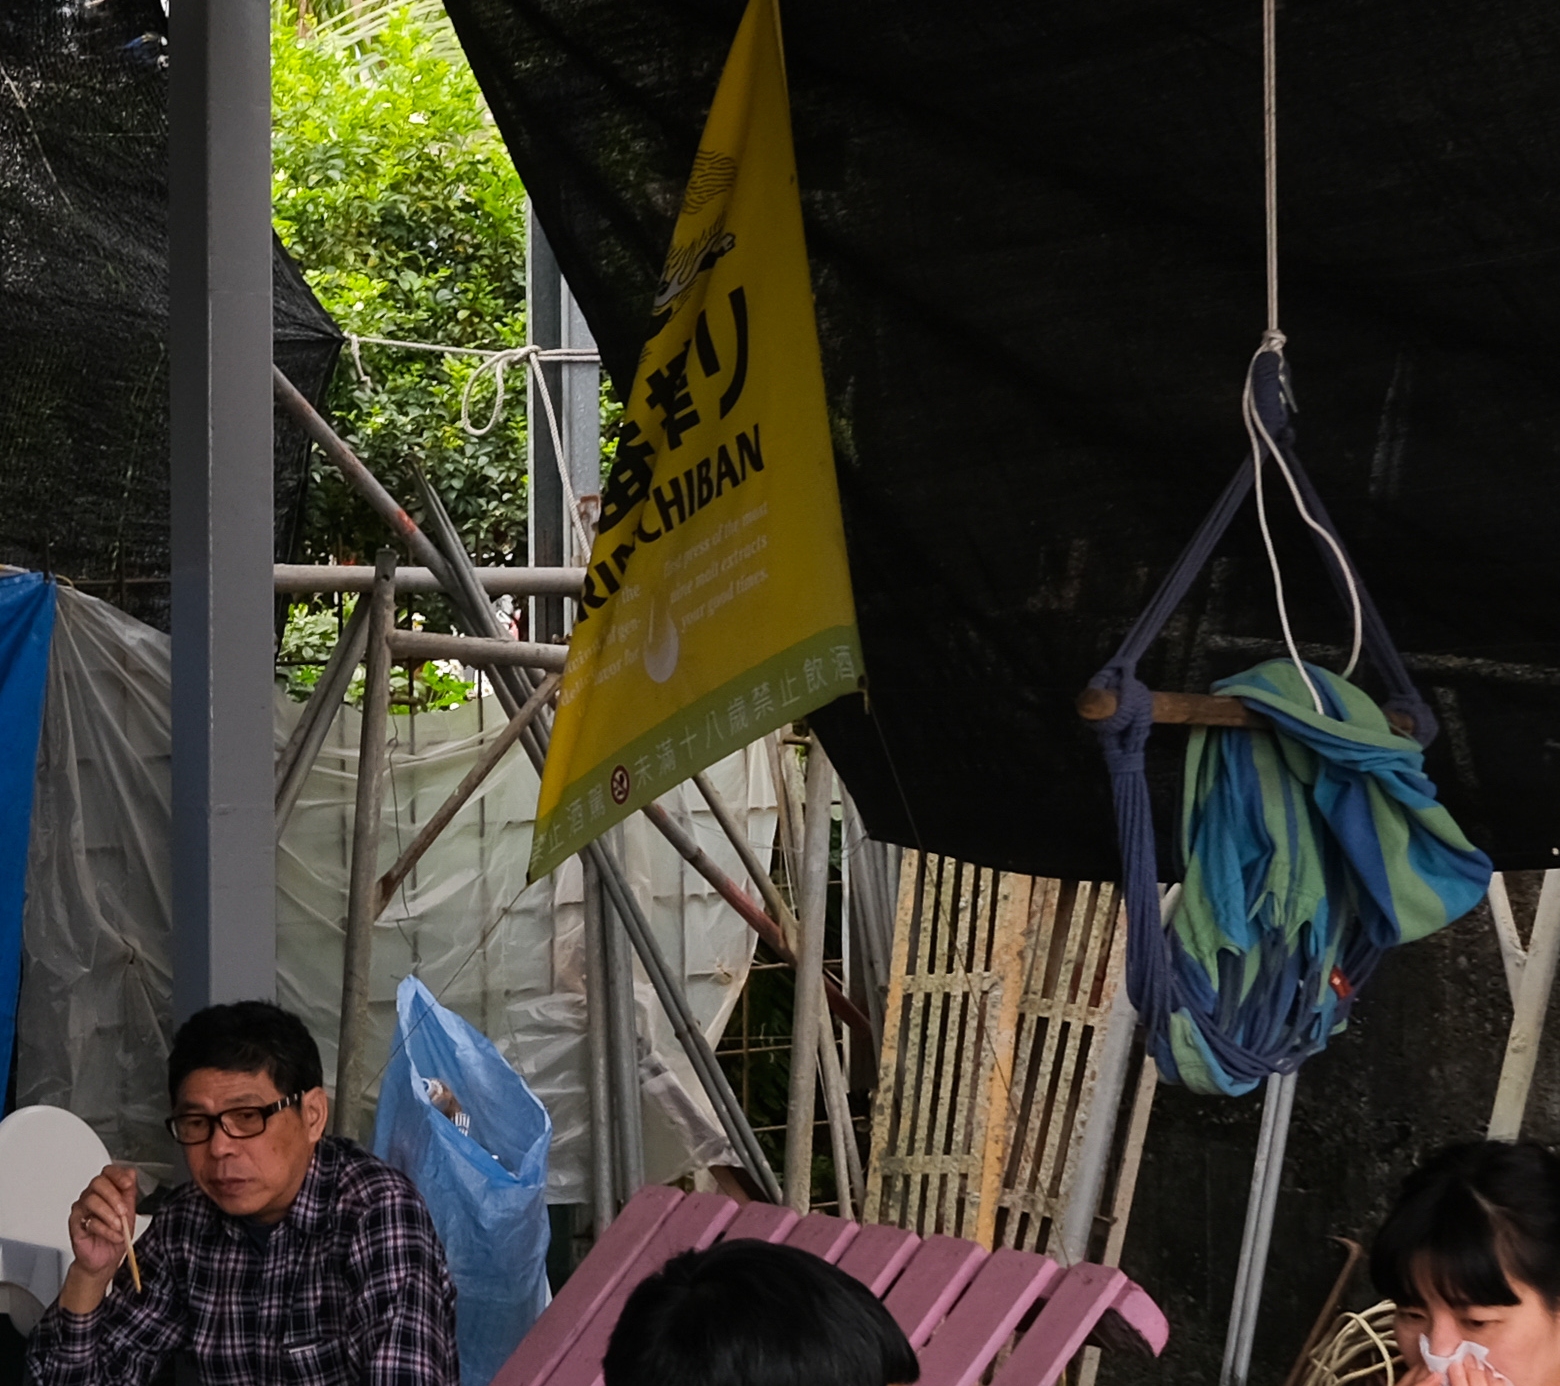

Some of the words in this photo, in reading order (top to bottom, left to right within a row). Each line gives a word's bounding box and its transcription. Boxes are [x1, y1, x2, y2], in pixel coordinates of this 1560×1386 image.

[636, 421, 765, 544] CHIBAN
[634, 644, 857, 791] 未滿十八歲禁止飲酒
